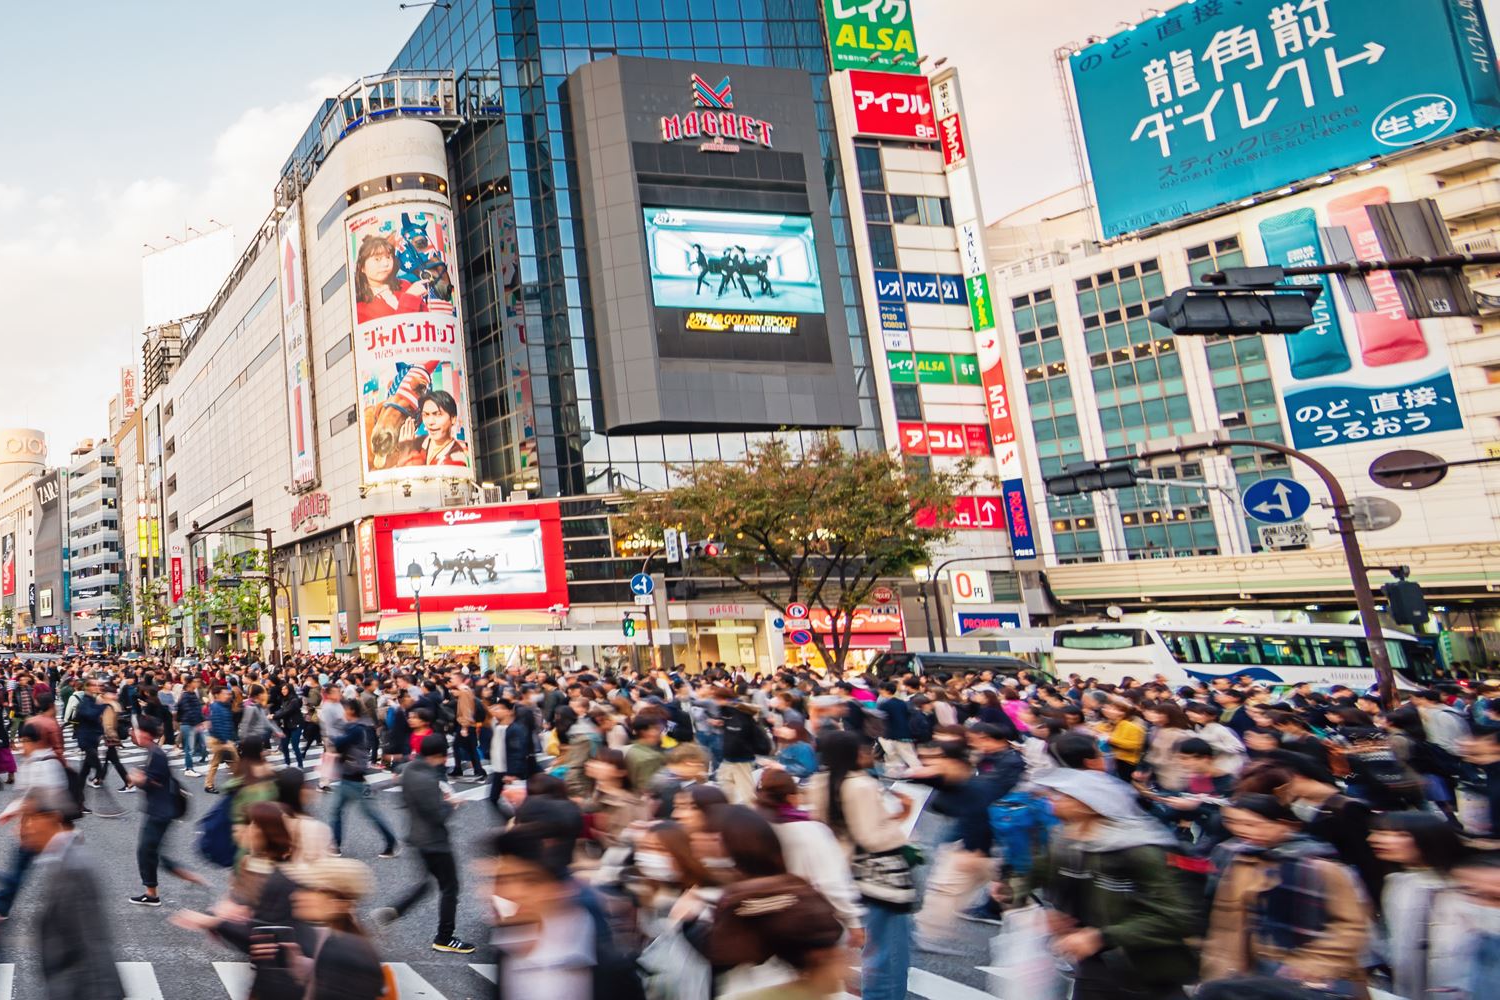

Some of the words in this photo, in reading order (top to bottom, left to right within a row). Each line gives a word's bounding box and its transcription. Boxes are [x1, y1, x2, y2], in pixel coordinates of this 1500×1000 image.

[835, 24, 915, 53] ALSA
[1142, 0, 1336, 107] 龍角散
[854, 90, 931, 115] アイフル
[1130, 41, 1387, 158] ダイレクト
[660, 110, 774, 148] MAGNET
[915, 124, 934, 138] 8F
[363, 320, 456, 351] ジャパンカップ
[917, 360, 946, 372] ALSA
[1295, 386, 1453, 423] のど、直接、
[906, 429, 963, 448] アコム
[1314, 412, 1432, 443] うるおう
[37, 480, 59, 505] ZARA
[1008, 491, 1028, 538] PROMISE
